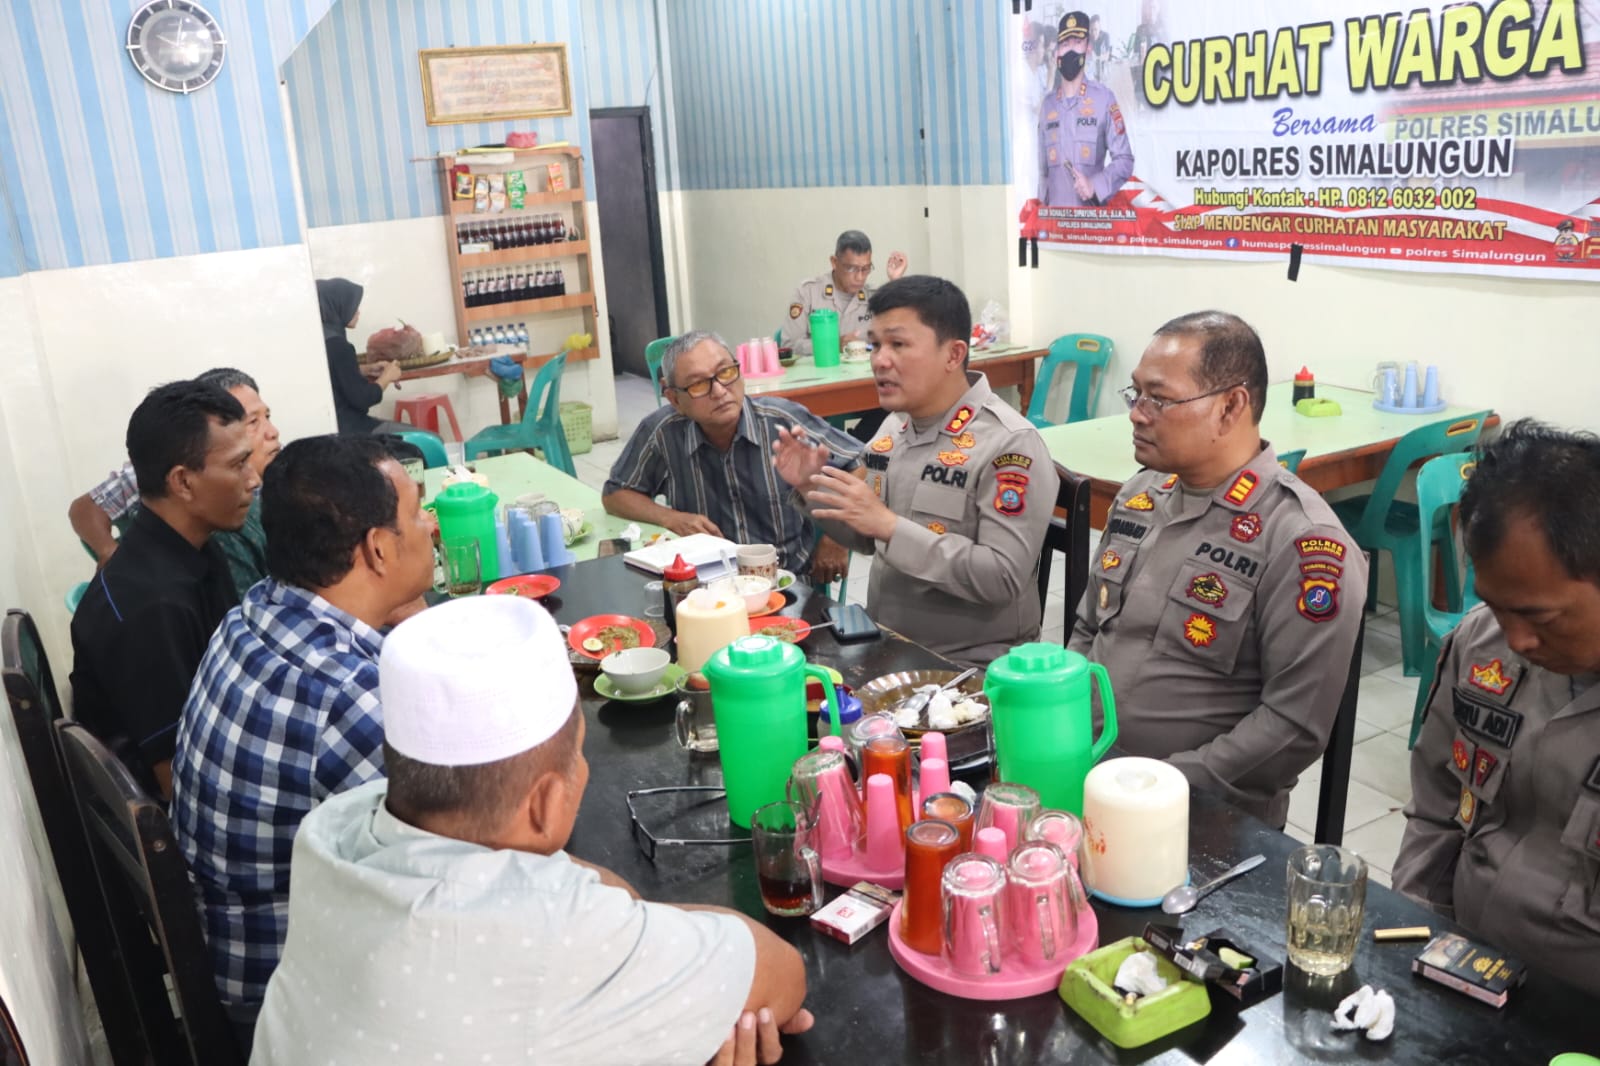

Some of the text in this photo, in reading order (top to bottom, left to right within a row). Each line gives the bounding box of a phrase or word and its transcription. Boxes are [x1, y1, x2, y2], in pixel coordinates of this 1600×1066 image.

[1143, 0, 1586, 108] CURHAT WARGA
[1272, 107, 1376, 137] Bersama
[1395, 114, 1488, 139] POLRES
[1176, 138, 1511, 177] KAPOLRES SIMALUNGUN
[1194, 187, 1248, 209] Hubungi
[1252, 188, 1305, 207] Kontak
[1318, 187, 1344, 208] HP.
[1347, 186, 1389, 208] 0812
[1392, 187, 1436, 209] 6032
[1440, 186, 1477, 209] 002
[1174, 214, 1508, 241] SIAP MENDENGAR CURHATAN MASYARAKAT
[1406, 247, 1546, 263] polres Simalungun
[921, 464, 968, 489] POLRI
[1195, 541, 1258, 578] POLRI
